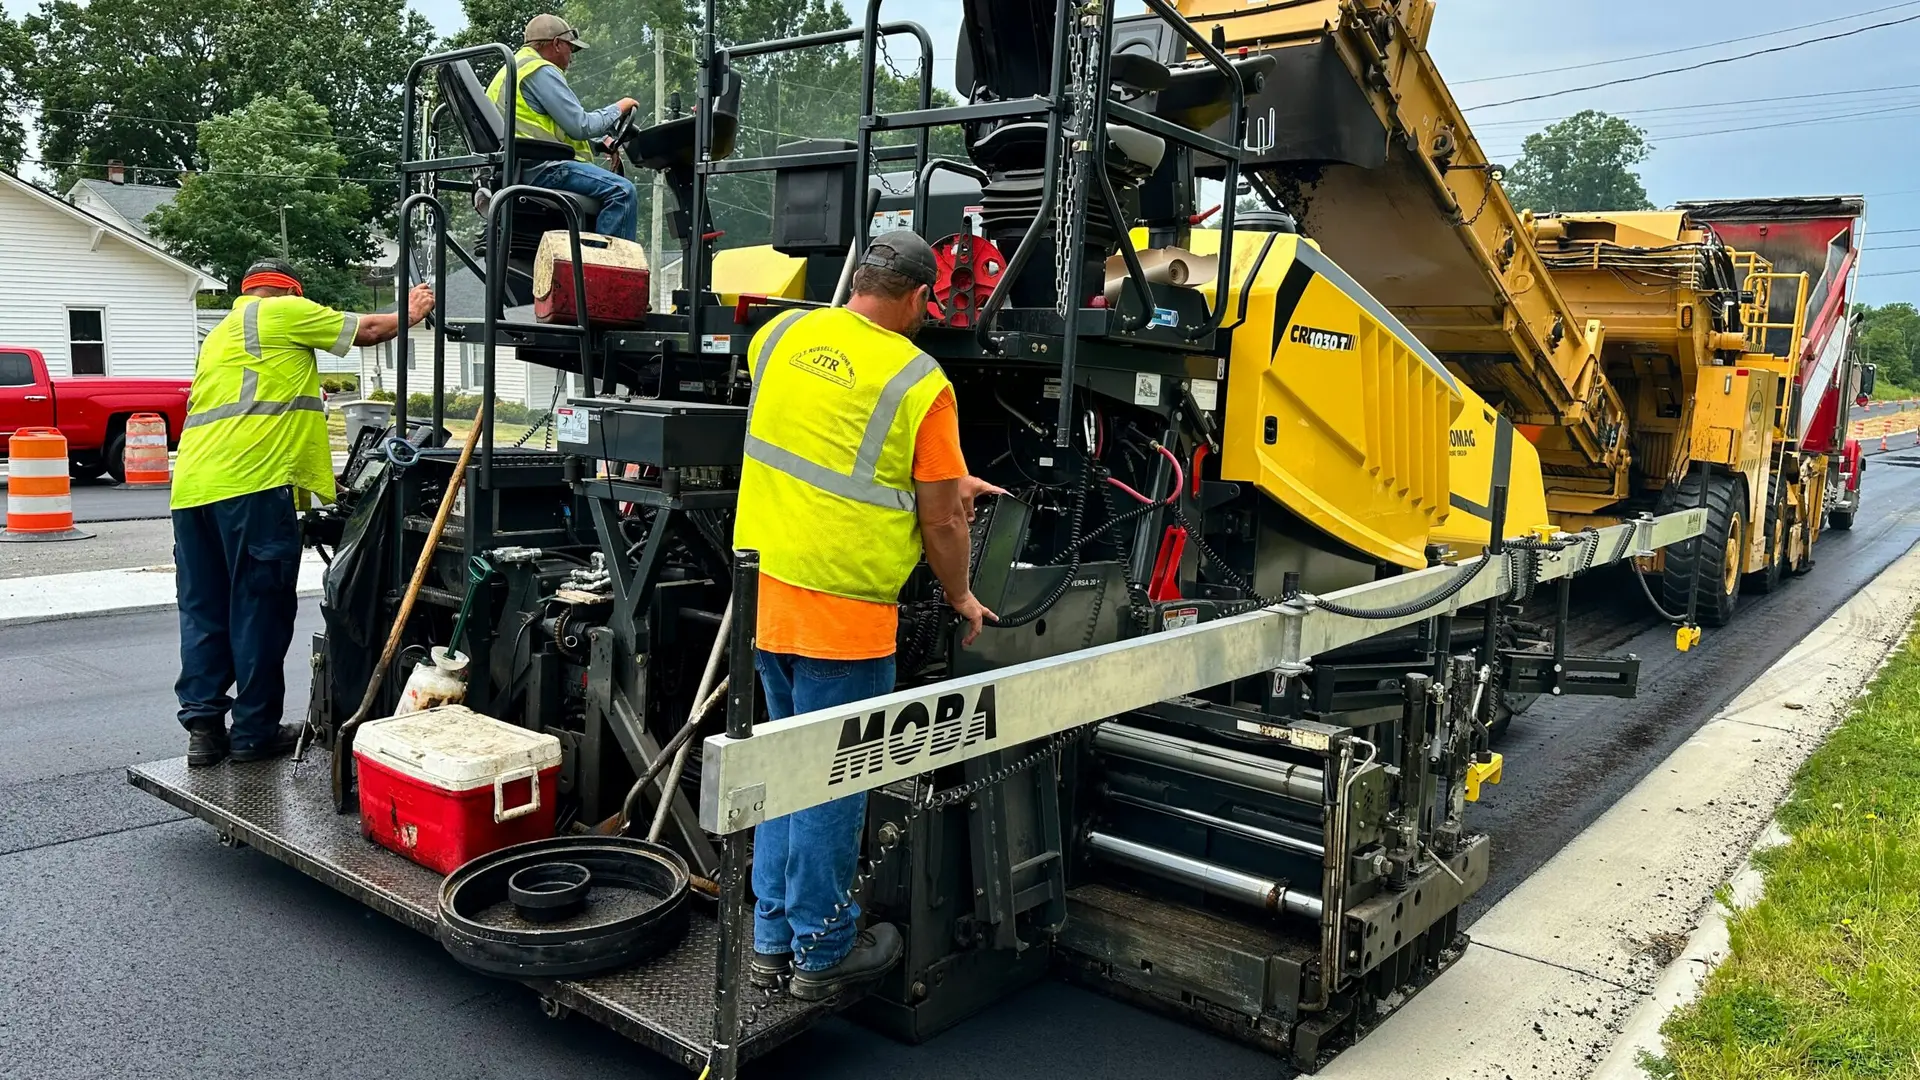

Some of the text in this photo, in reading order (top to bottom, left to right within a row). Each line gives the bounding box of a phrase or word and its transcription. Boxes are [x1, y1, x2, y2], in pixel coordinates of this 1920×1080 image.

[808, 345, 834, 354] RUSSELL
[812, 353, 840, 373] JTR
[1449, 429, 1476, 447] OMAG
[828, 684, 997, 786] MOBA
